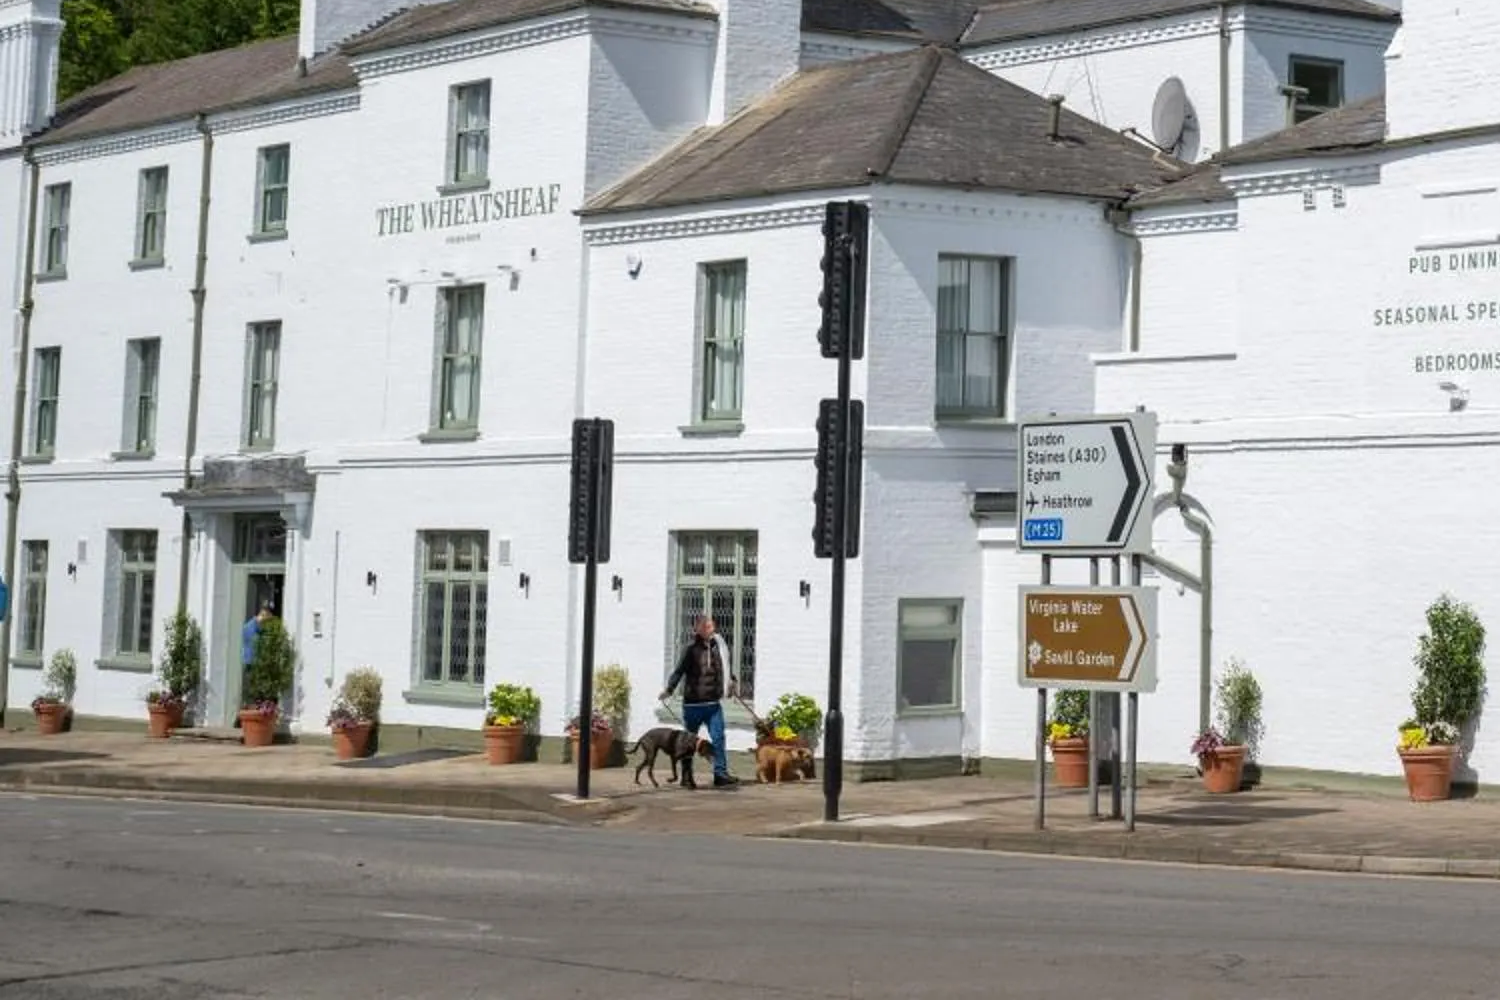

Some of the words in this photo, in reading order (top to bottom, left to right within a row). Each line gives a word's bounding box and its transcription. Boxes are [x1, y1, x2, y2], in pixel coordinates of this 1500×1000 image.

[376, 204, 414, 236] THE
[421, 183, 561, 230] WHEATSHEAF
[1409, 255, 1441, 274] PUB
[1373, 304, 1459, 326] SEASONAL
[1027, 433, 1064, 447] London
[1027, 451, 1065, 465] Staines
[1069, 446, 1106, 464] (A30)
[1027, 468, 1060, 484] Egham
[1042, 495, 1093, 509] Heathrow
[1029, 599, 1068, 617] Virginia
[1071, 600, 1103, 615] Water
[1053, 618, 1079, 633] Lake
[1044, 649, 1074, 665] Savill
[1075, 650, 1115, 667] Garden
